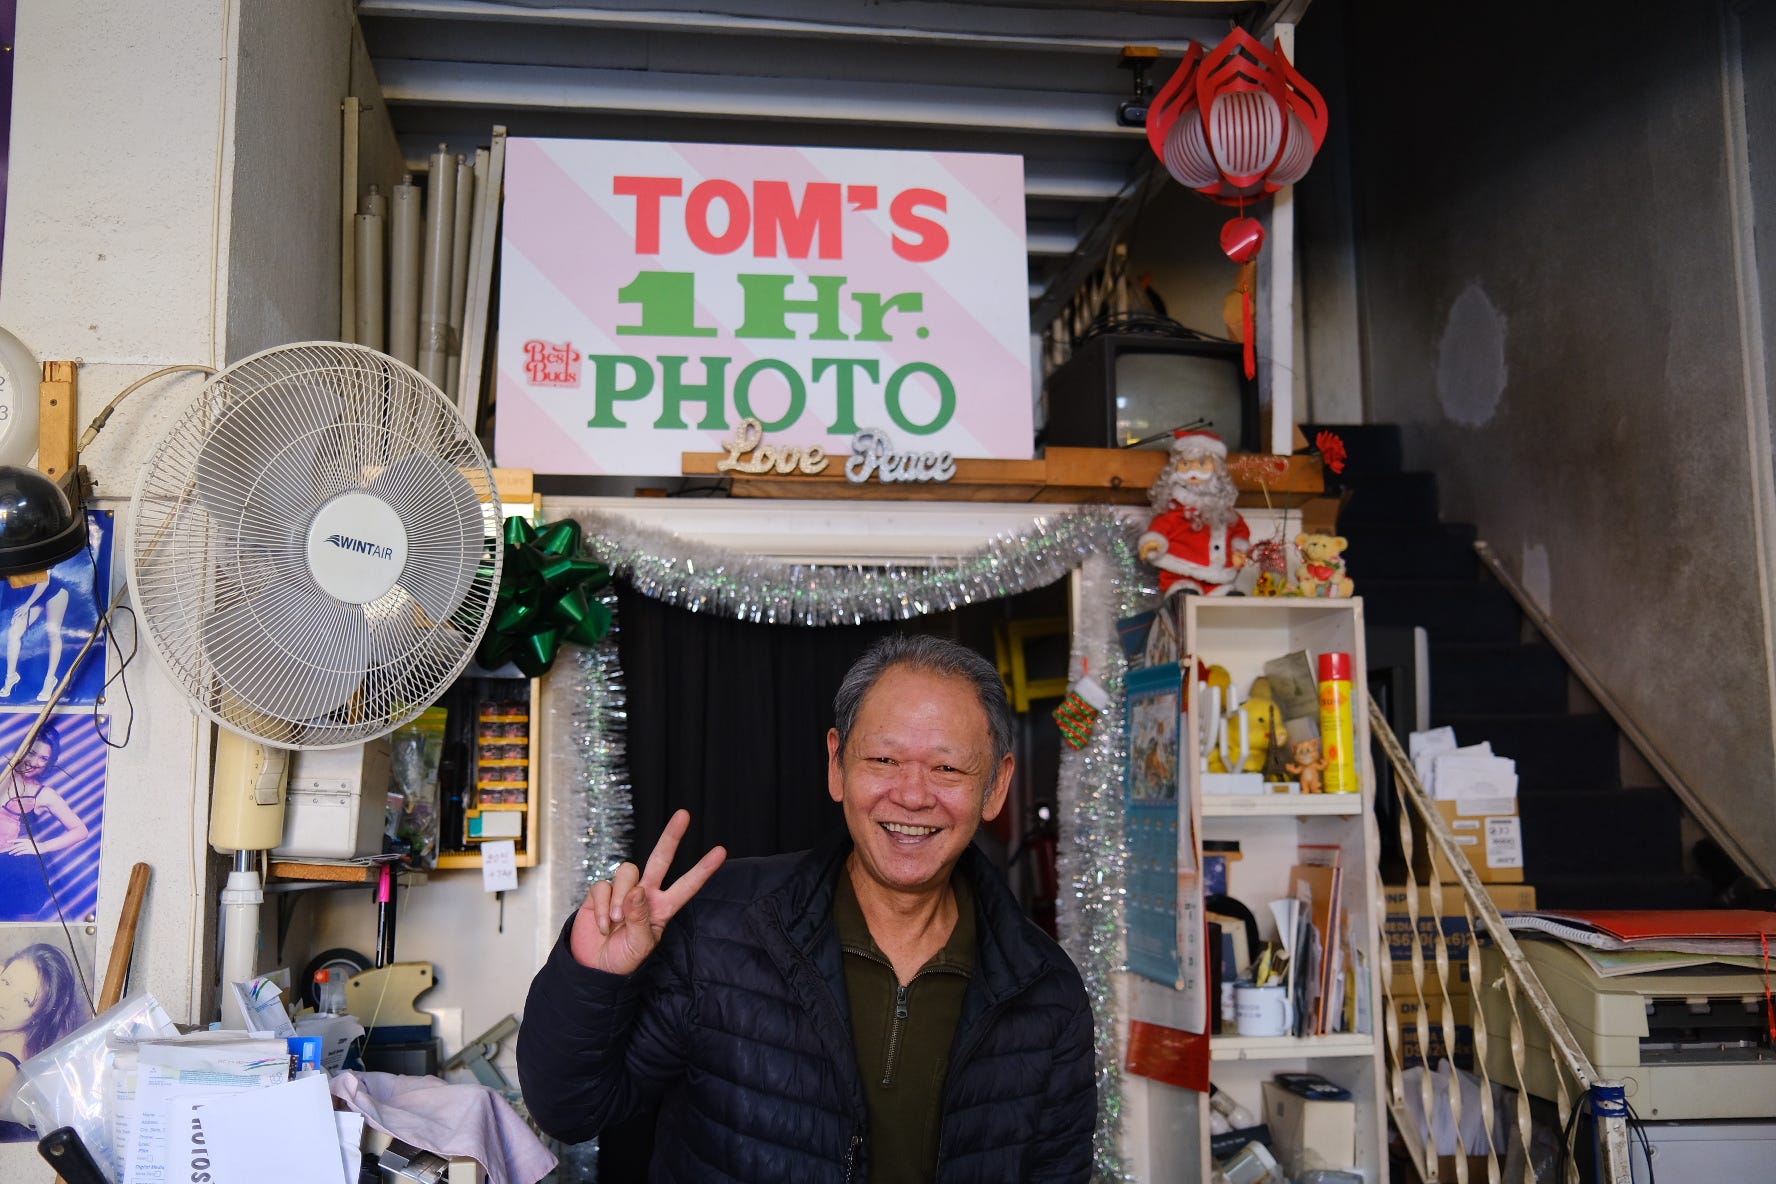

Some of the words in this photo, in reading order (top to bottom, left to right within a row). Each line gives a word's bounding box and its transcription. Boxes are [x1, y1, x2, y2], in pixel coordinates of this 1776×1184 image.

[613, 175, 950, 262] TOM'S
[616, 270, 718, 338] 1
[735, 273, 930, 342] Hr.
[523, 340, 580, 364] Best
[525, 359, 577, 383] Buds
[587, 354, 957, 436] PHOTO
[717, 417, 829, 475] Love
[845, 427, 957, 484] Peace
[340, 535, 393, 561] WINTAIR
[1385, 893, 1407, 903] NP
